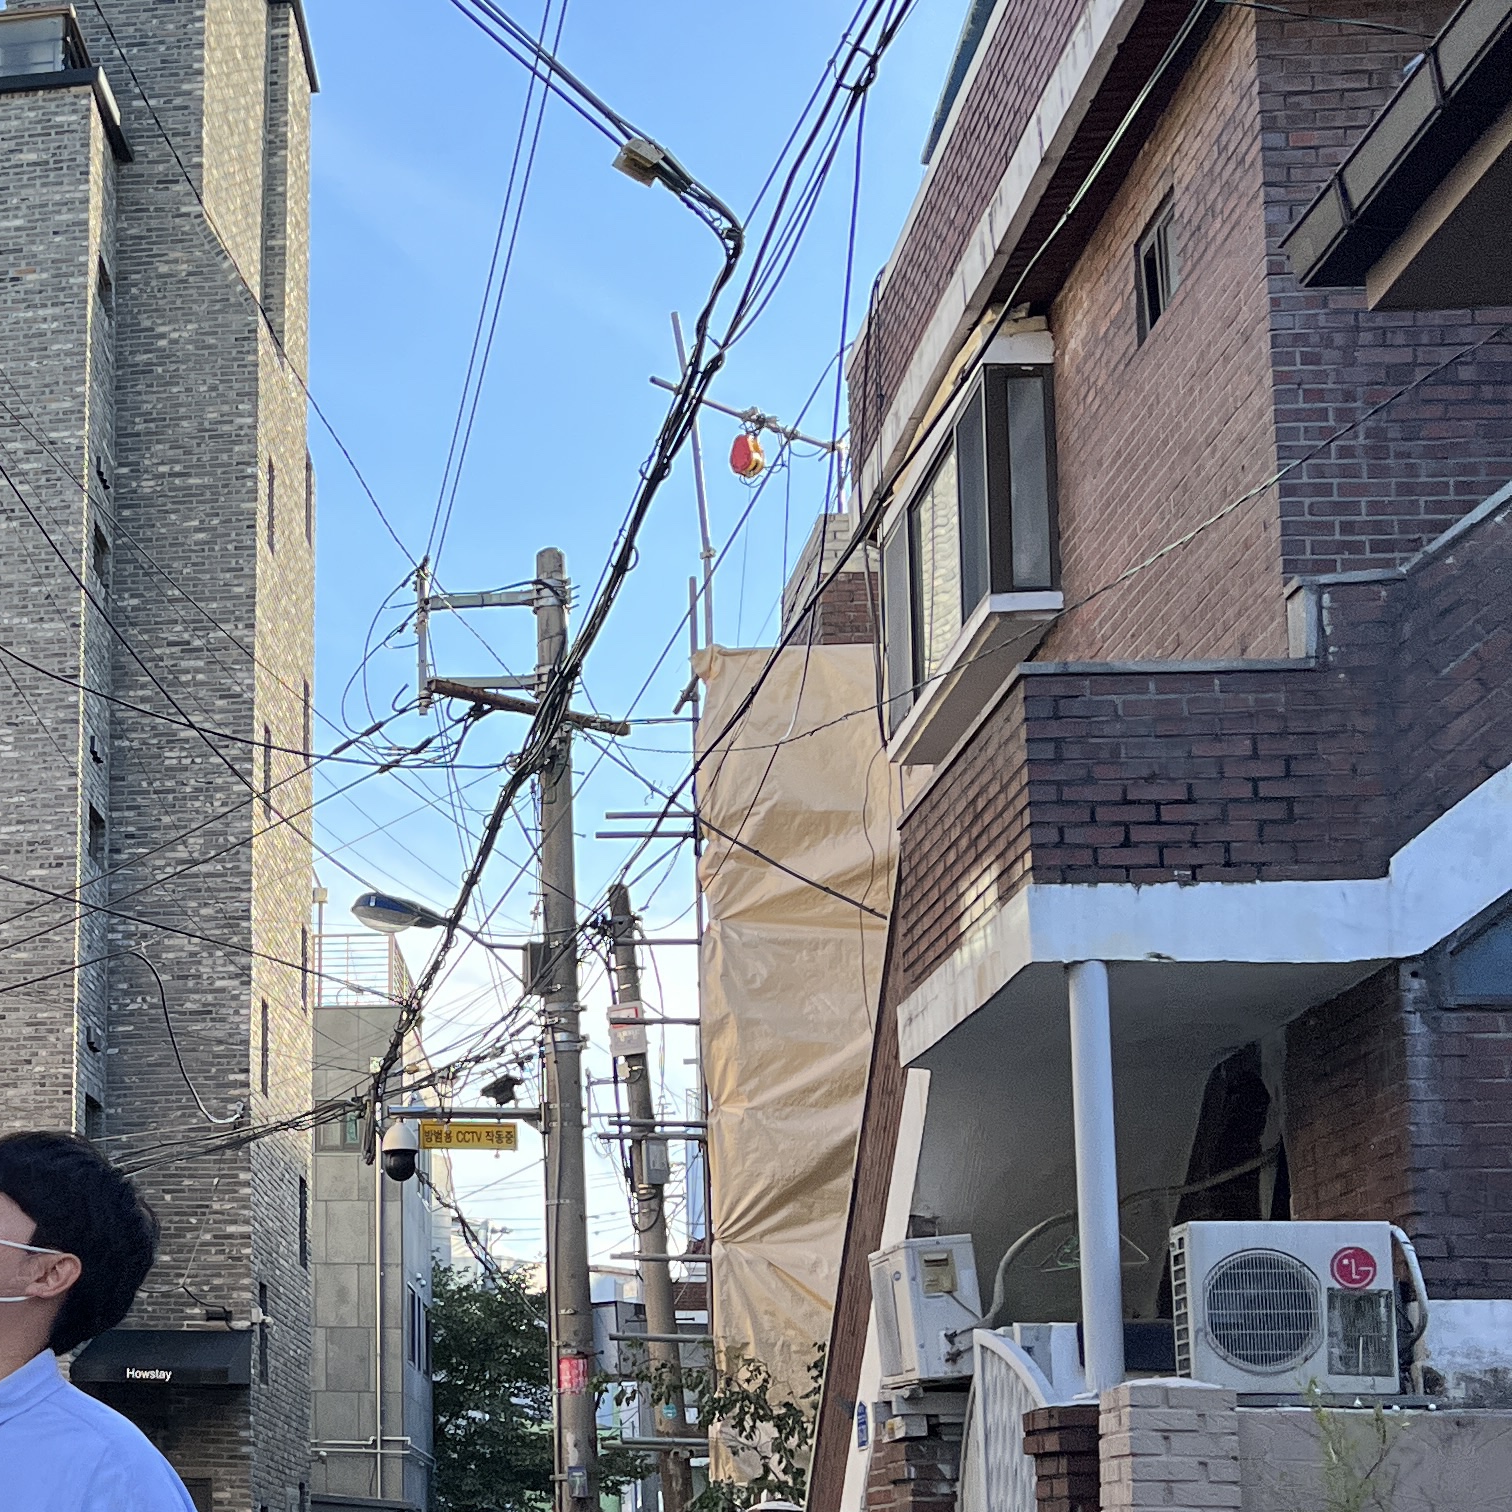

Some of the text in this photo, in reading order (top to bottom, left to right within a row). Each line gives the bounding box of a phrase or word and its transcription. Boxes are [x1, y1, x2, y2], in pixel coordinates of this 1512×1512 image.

[456, 1130, 482, 1143] CCTV
[485, 1129, 514, 1144] 작동중
[126, 1367, 172, 1382] Howstay
